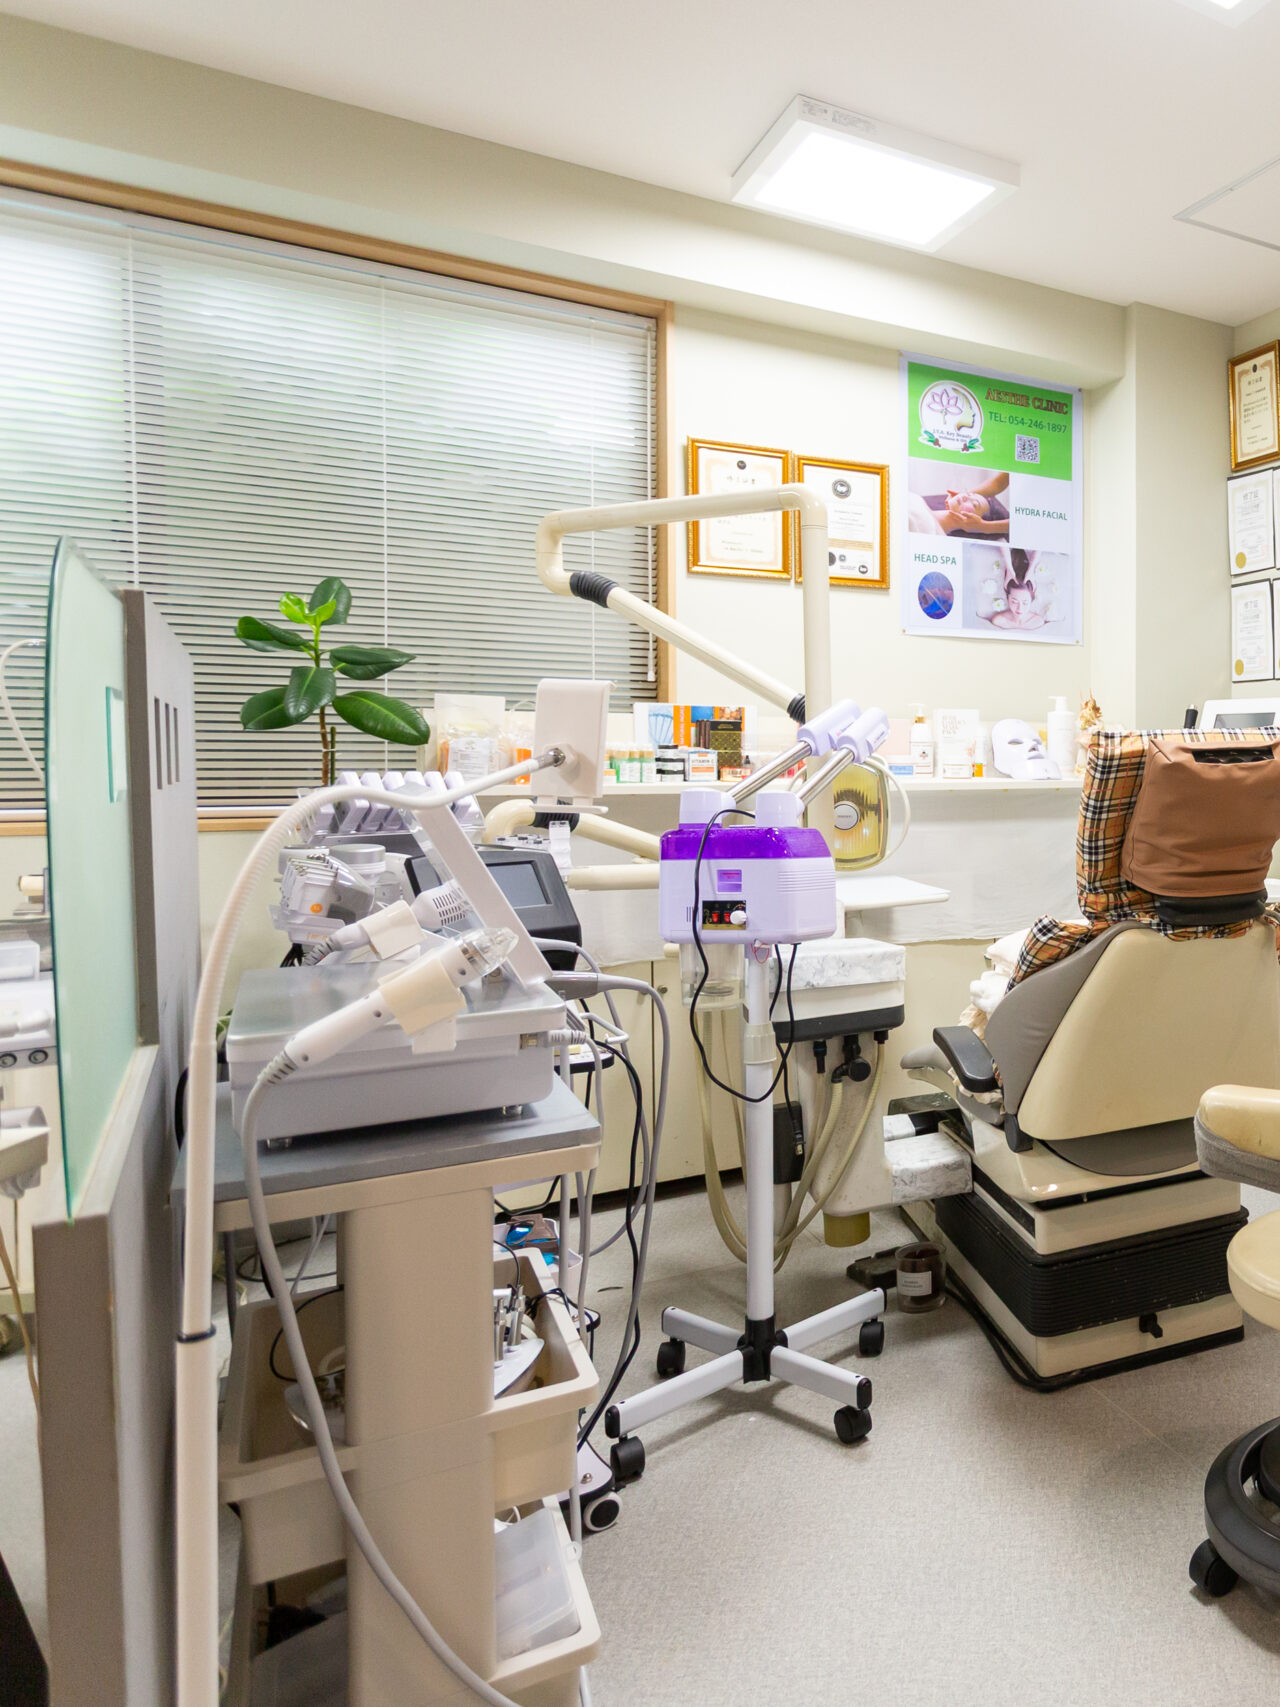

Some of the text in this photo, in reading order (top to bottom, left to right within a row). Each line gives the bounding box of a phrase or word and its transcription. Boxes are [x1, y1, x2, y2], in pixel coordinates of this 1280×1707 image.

[1032, 397, 1069, 415] CLINIC
[988, 411, 1068, 433] TEL: 054-246-1897
[1014, 506, 1068, 521] HYDRA FACIAL
[914, 553, 957, 566] HEAD SPA
